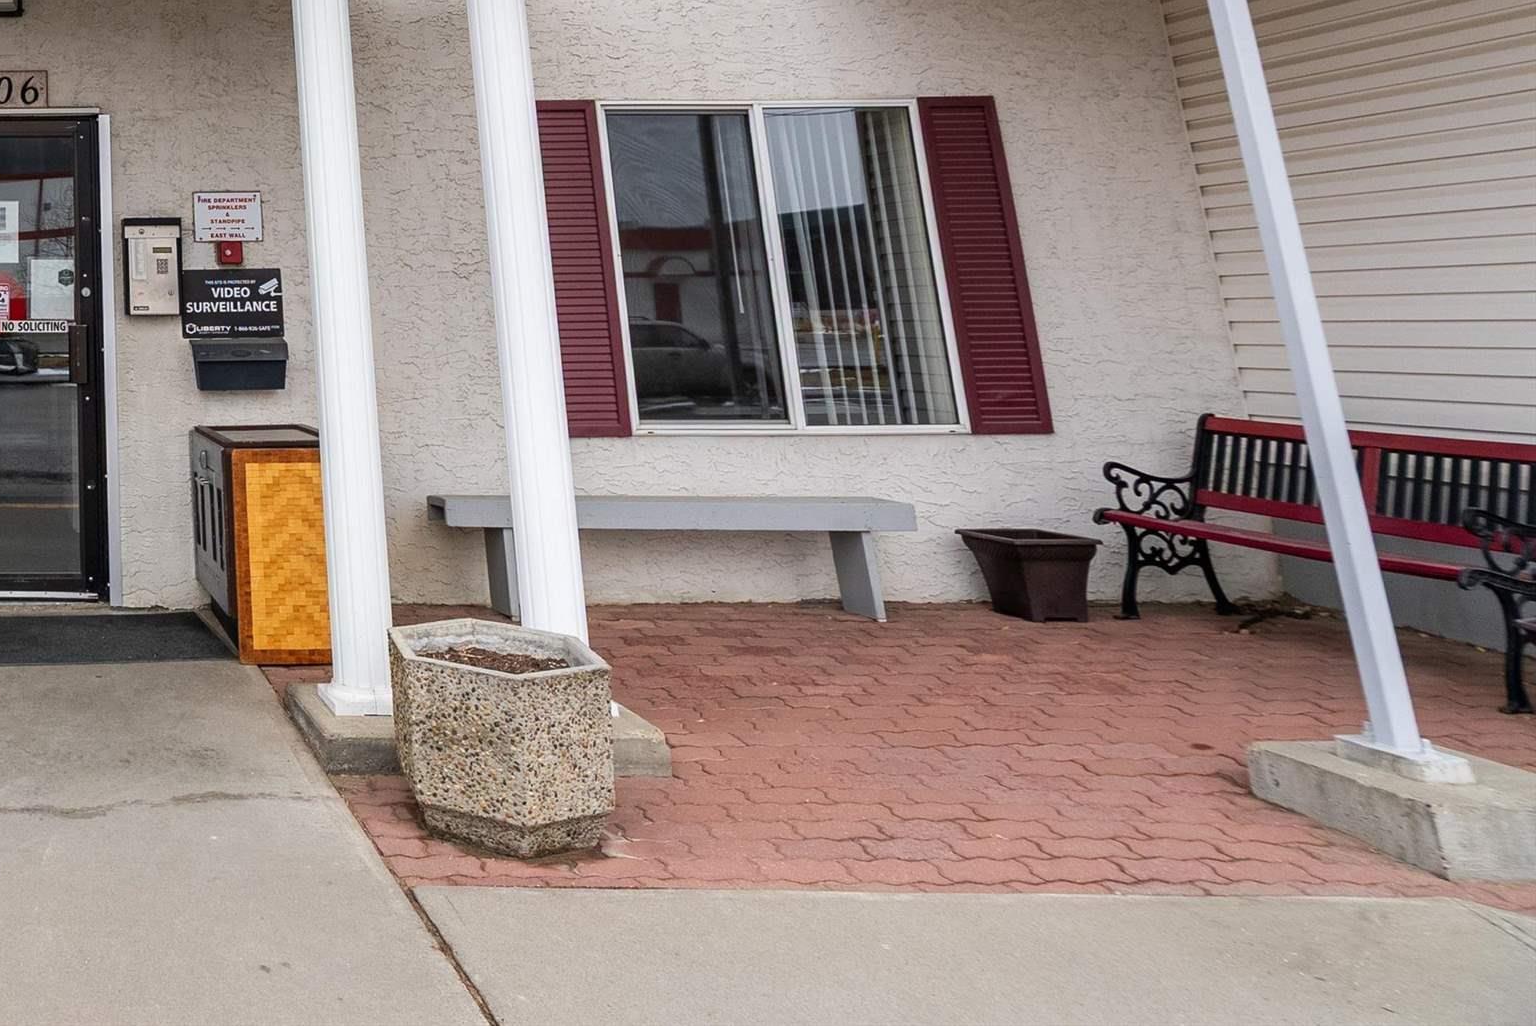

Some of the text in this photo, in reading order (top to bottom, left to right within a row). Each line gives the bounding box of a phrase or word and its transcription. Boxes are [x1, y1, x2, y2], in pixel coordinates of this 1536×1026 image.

[211, 287, 250, 298] VIDEO
[186, 301, 278, 313] SURVEILLANCE
[1, 322, 66, 332] NO SOLICITING
